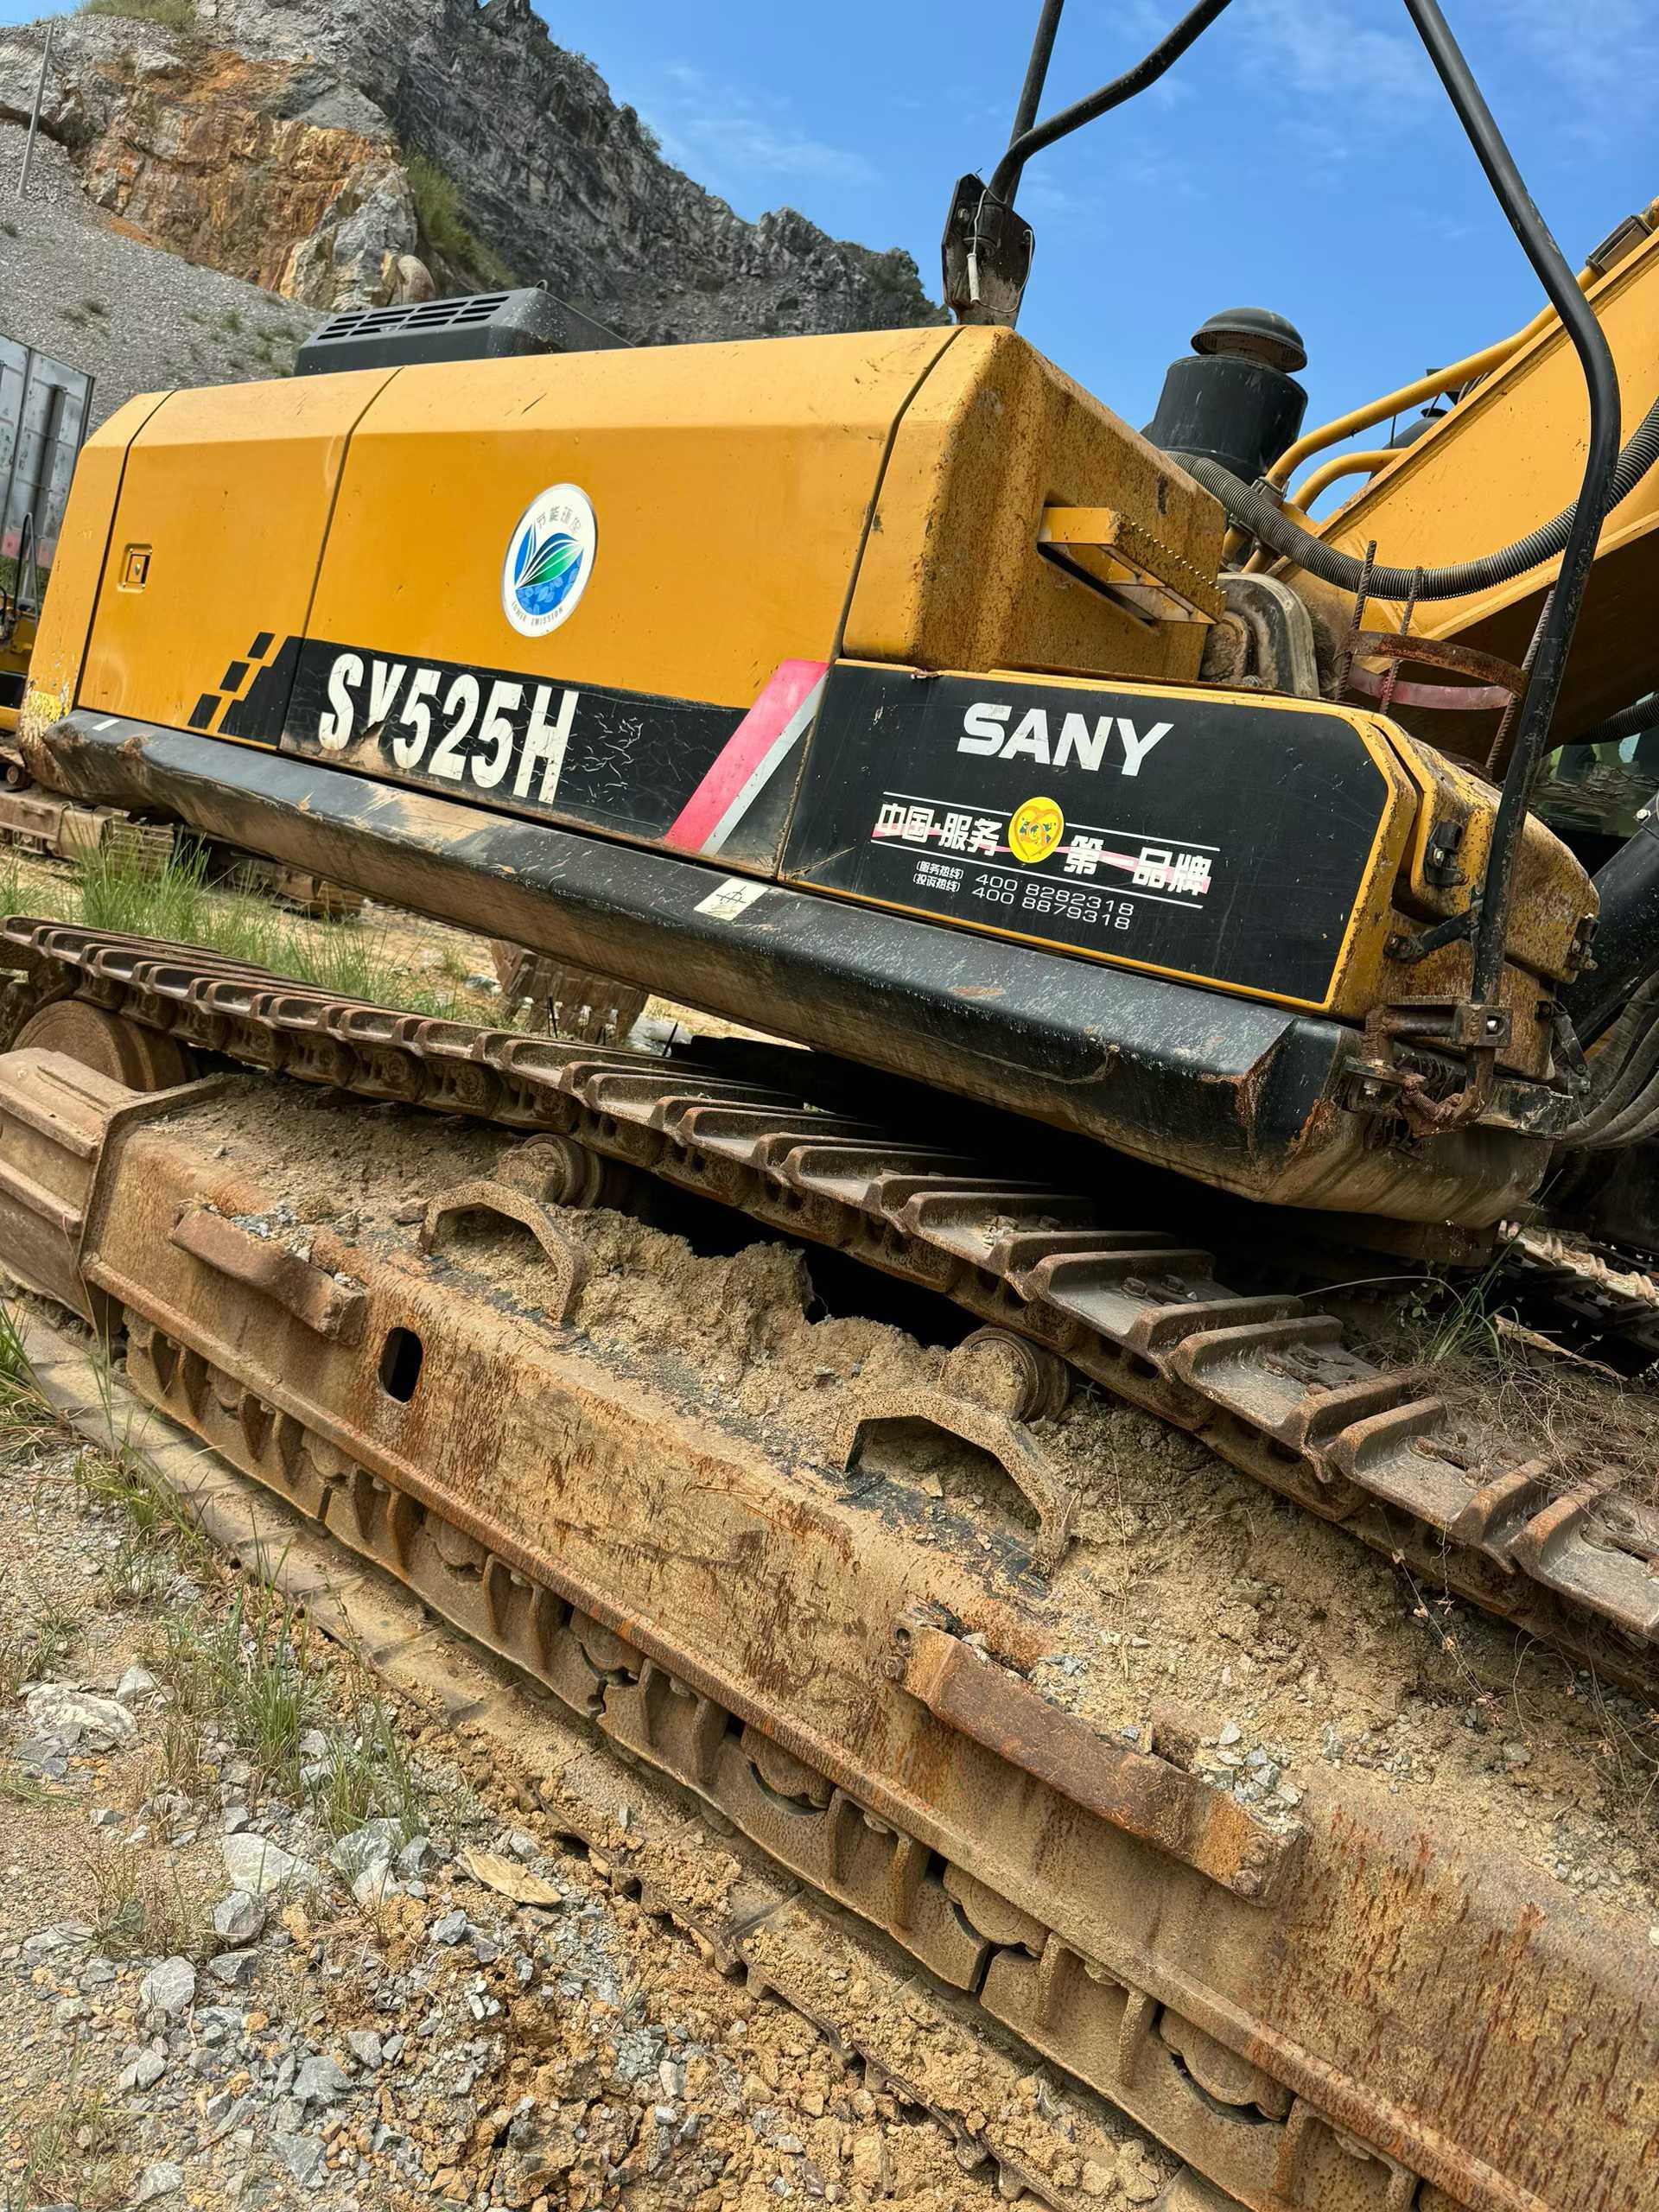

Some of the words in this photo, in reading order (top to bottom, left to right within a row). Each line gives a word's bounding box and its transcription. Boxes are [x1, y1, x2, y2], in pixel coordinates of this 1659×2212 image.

[318, 652, 580, 804] SY525H
[957, 702, 1175, 777] SANY
[975, 874, 1018, 892] 400
[1025, 883, 1135, 917] 8282318
[1064, 835, 1212, 896] 第一品牌
[971, 887, 1014, 905] 400
[1021, 897, 1132, 931] 8879318
